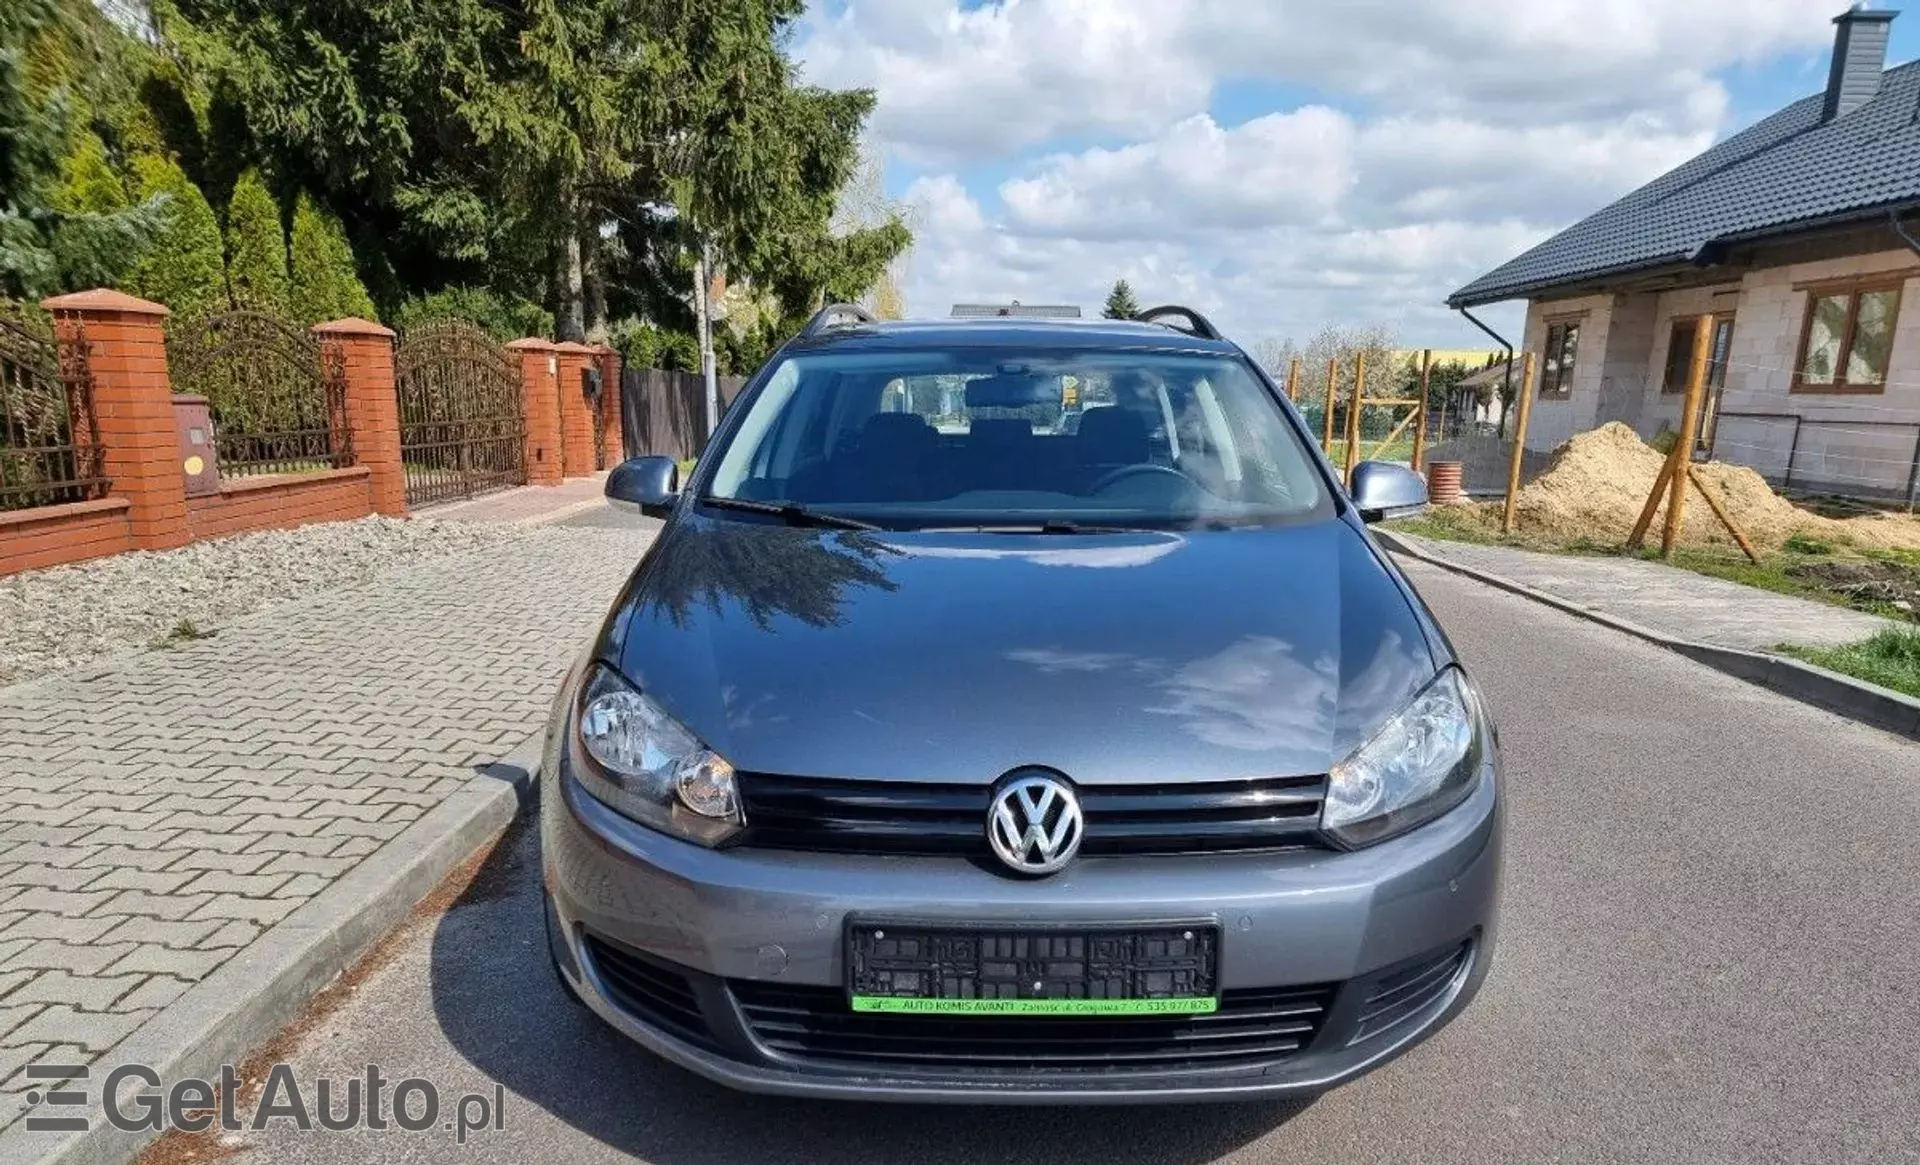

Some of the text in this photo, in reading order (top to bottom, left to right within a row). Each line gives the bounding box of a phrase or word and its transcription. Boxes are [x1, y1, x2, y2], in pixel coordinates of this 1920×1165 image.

[902, 1000, 934, 1010] AUTO
[935, 1001, 972, 1011] KOMIS
[974, 1001, 1014, 1011] AVANTI
[1147, 1001, 1166, 1011] 535
